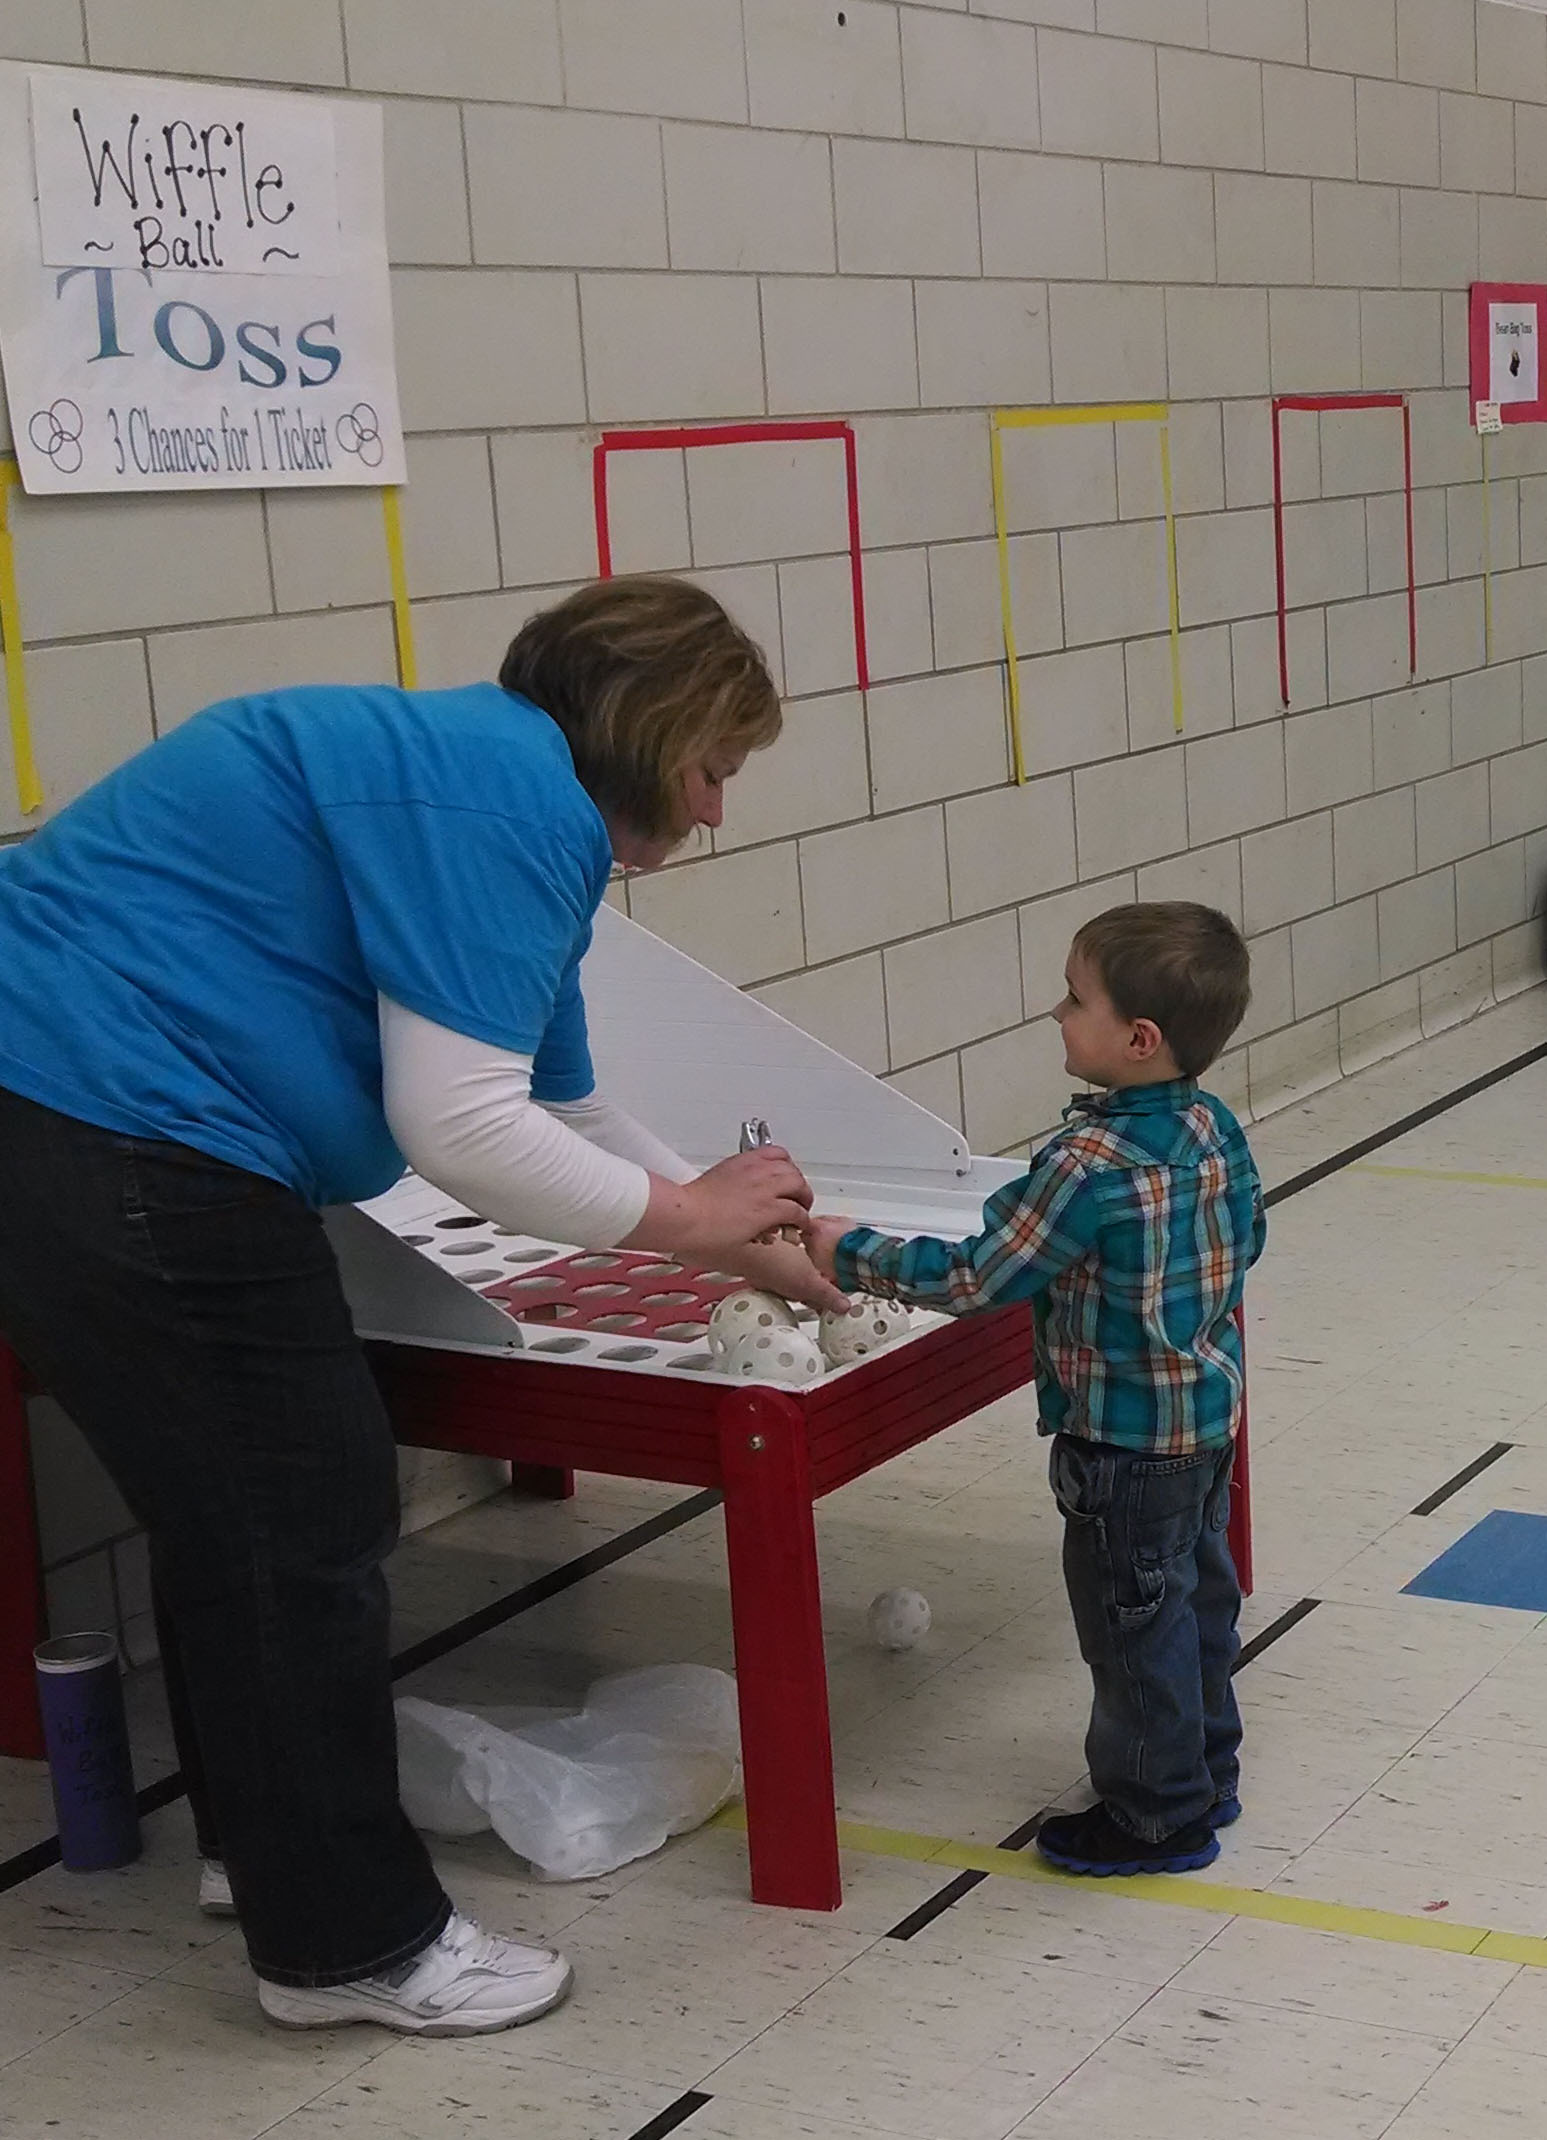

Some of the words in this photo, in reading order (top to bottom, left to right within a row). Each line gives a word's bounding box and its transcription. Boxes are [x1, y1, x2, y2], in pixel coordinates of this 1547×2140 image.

[73, 107, 295, 229] Wiffle
[134, 217, 224, 269] Ball
[56, 266, 342, 389] Toss
[107, 407, 125, 474] 3
[128, 406, 219, 475] Chances
[220, 405, 249, 473] for
[253, 406, 269, 471] 1
[268, 407, 333, 472] Ticket
